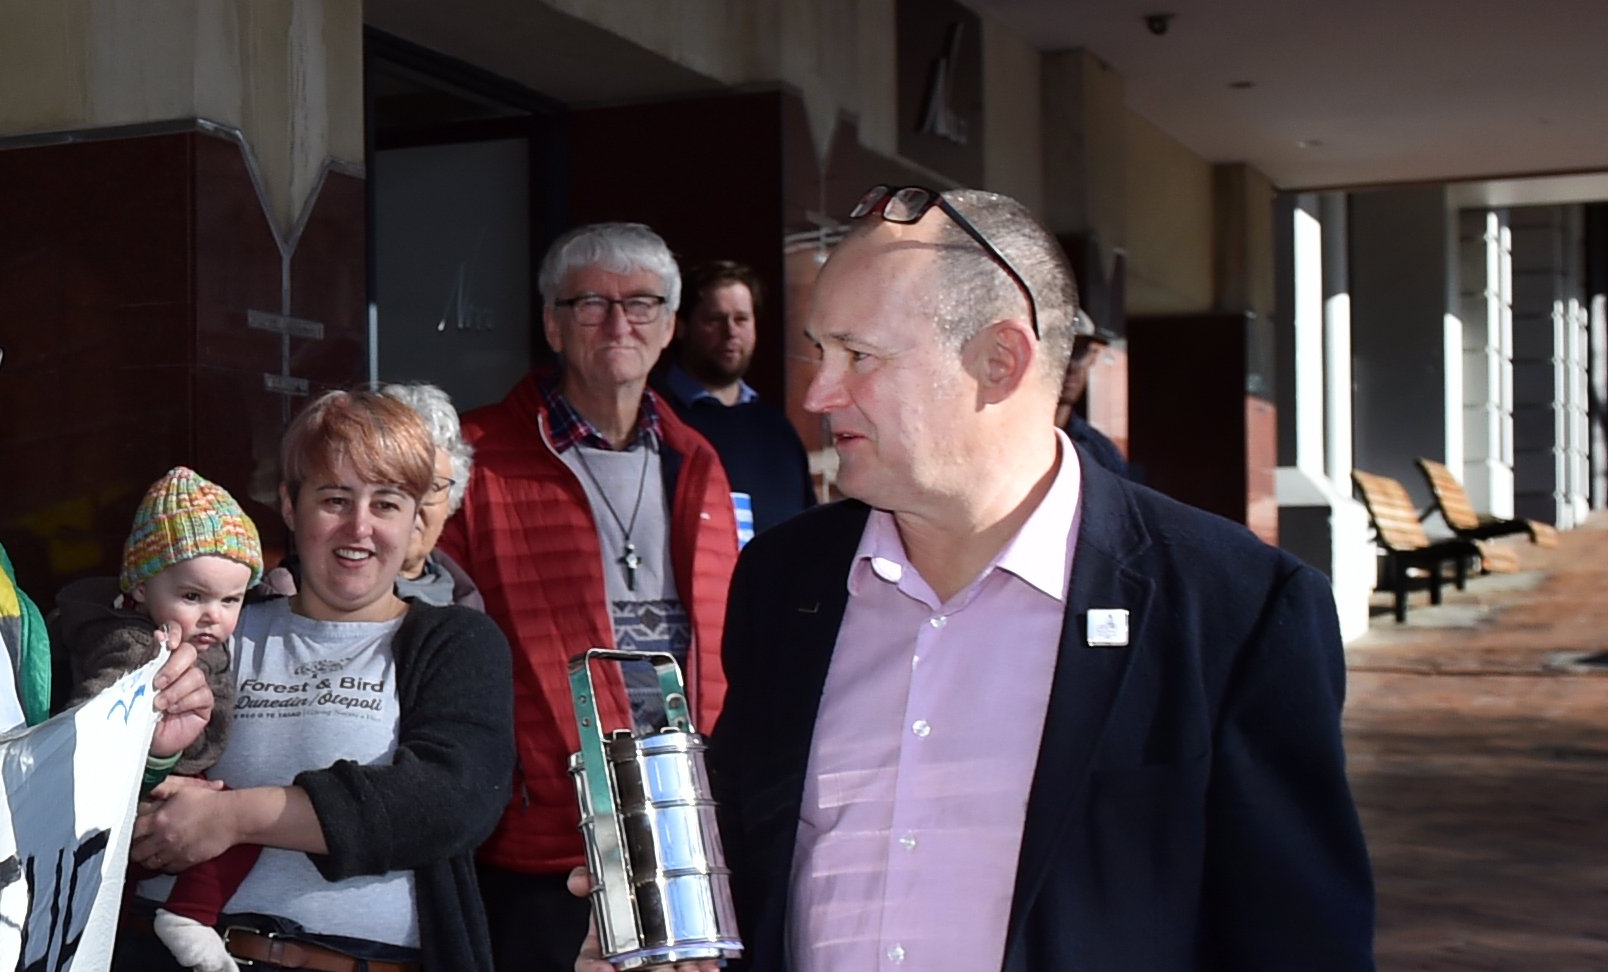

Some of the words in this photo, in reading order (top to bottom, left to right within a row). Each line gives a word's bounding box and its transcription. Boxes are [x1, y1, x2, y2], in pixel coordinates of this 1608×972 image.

[240, 679, 308, 693] Forest
[316, 678, 331, 690] &
[339, 677, 384, 692] Bird
